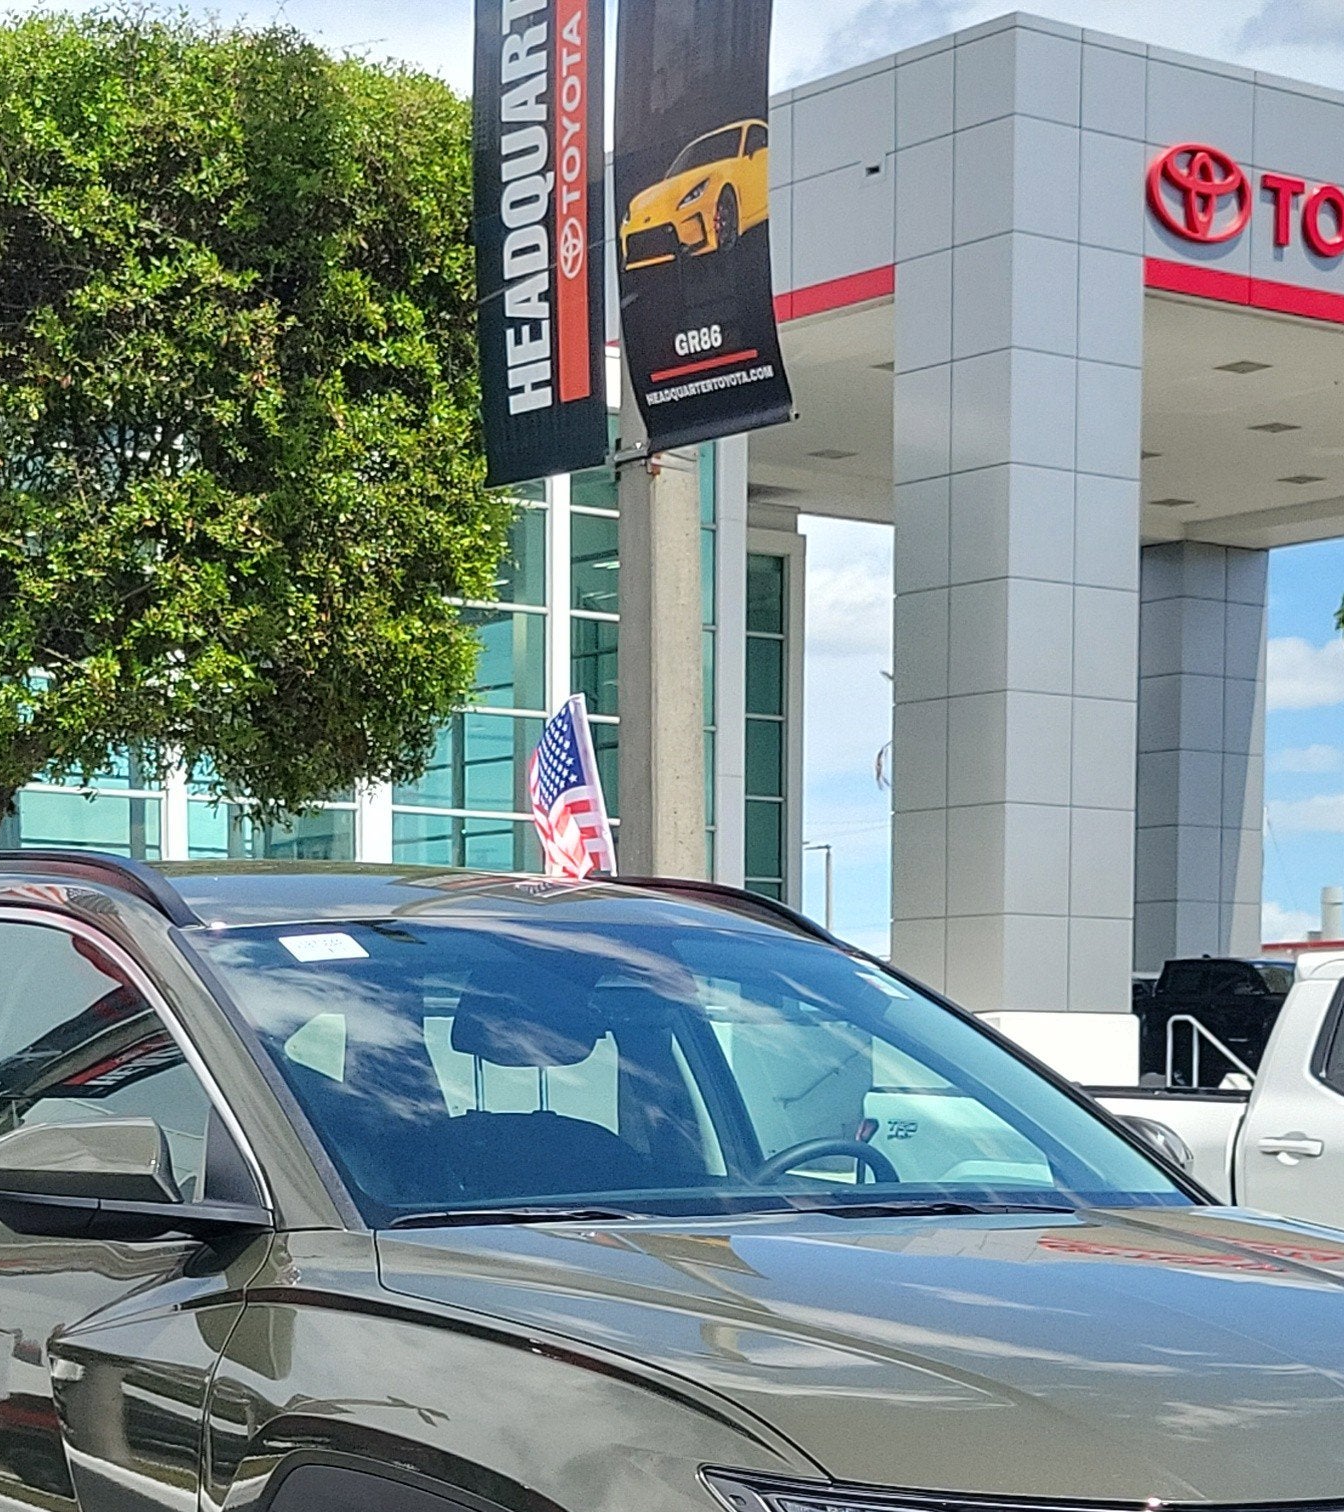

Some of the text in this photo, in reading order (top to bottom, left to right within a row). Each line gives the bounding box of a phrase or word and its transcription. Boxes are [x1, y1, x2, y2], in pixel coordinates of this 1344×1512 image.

[561, 10, 583, 213] TOYOTA
[675, 324, 723, 356] GR86
[646, 364, 775, 406] HEADQUARTERTOYOTA.COM
